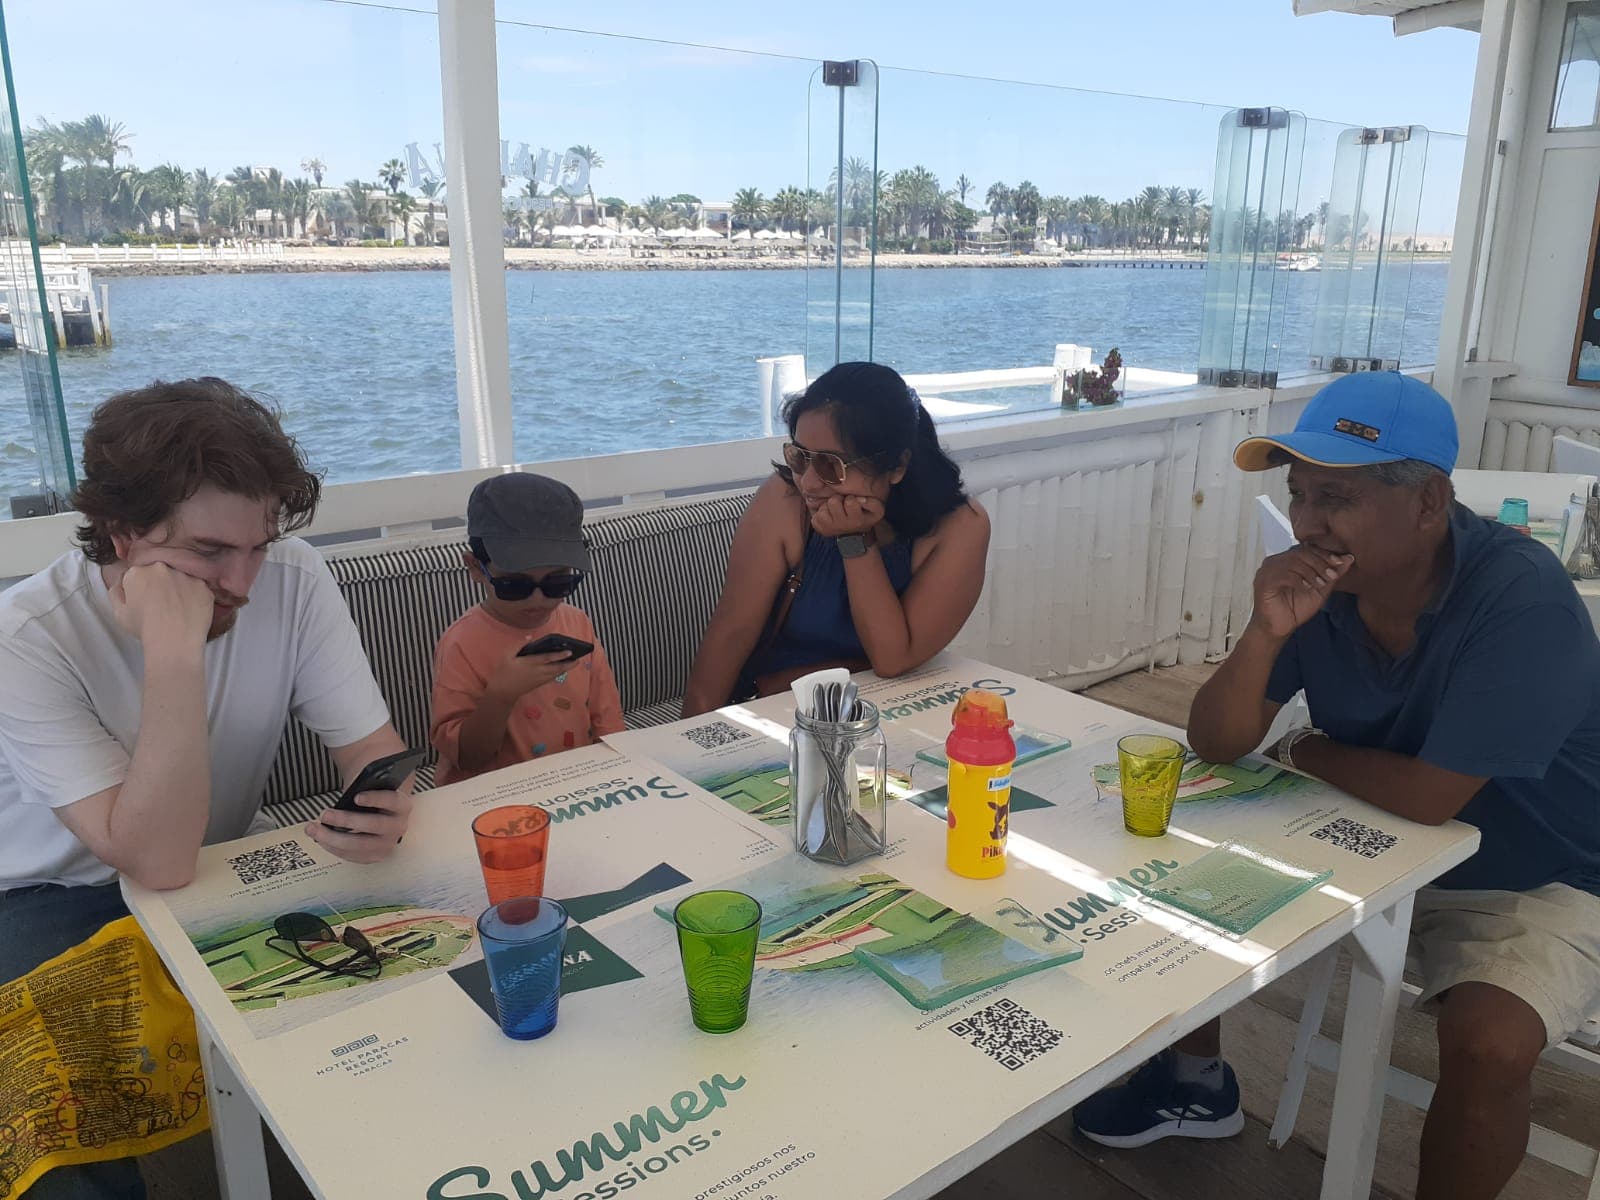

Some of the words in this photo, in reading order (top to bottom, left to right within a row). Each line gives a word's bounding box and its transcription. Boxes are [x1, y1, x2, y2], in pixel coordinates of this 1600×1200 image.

[316, 1059, 355, 1076] HOTEL
[358, 1036, 409, 1060] PARACAS
[345, 1051, 390, 1073] RESORT
[426, 1073, 747, 1200] Summer
[694, 1156, 772, 1200] prestigiosos
[773, 1143, 796, 1160] nos
[767, 1151, 816, 1181] nuestro
